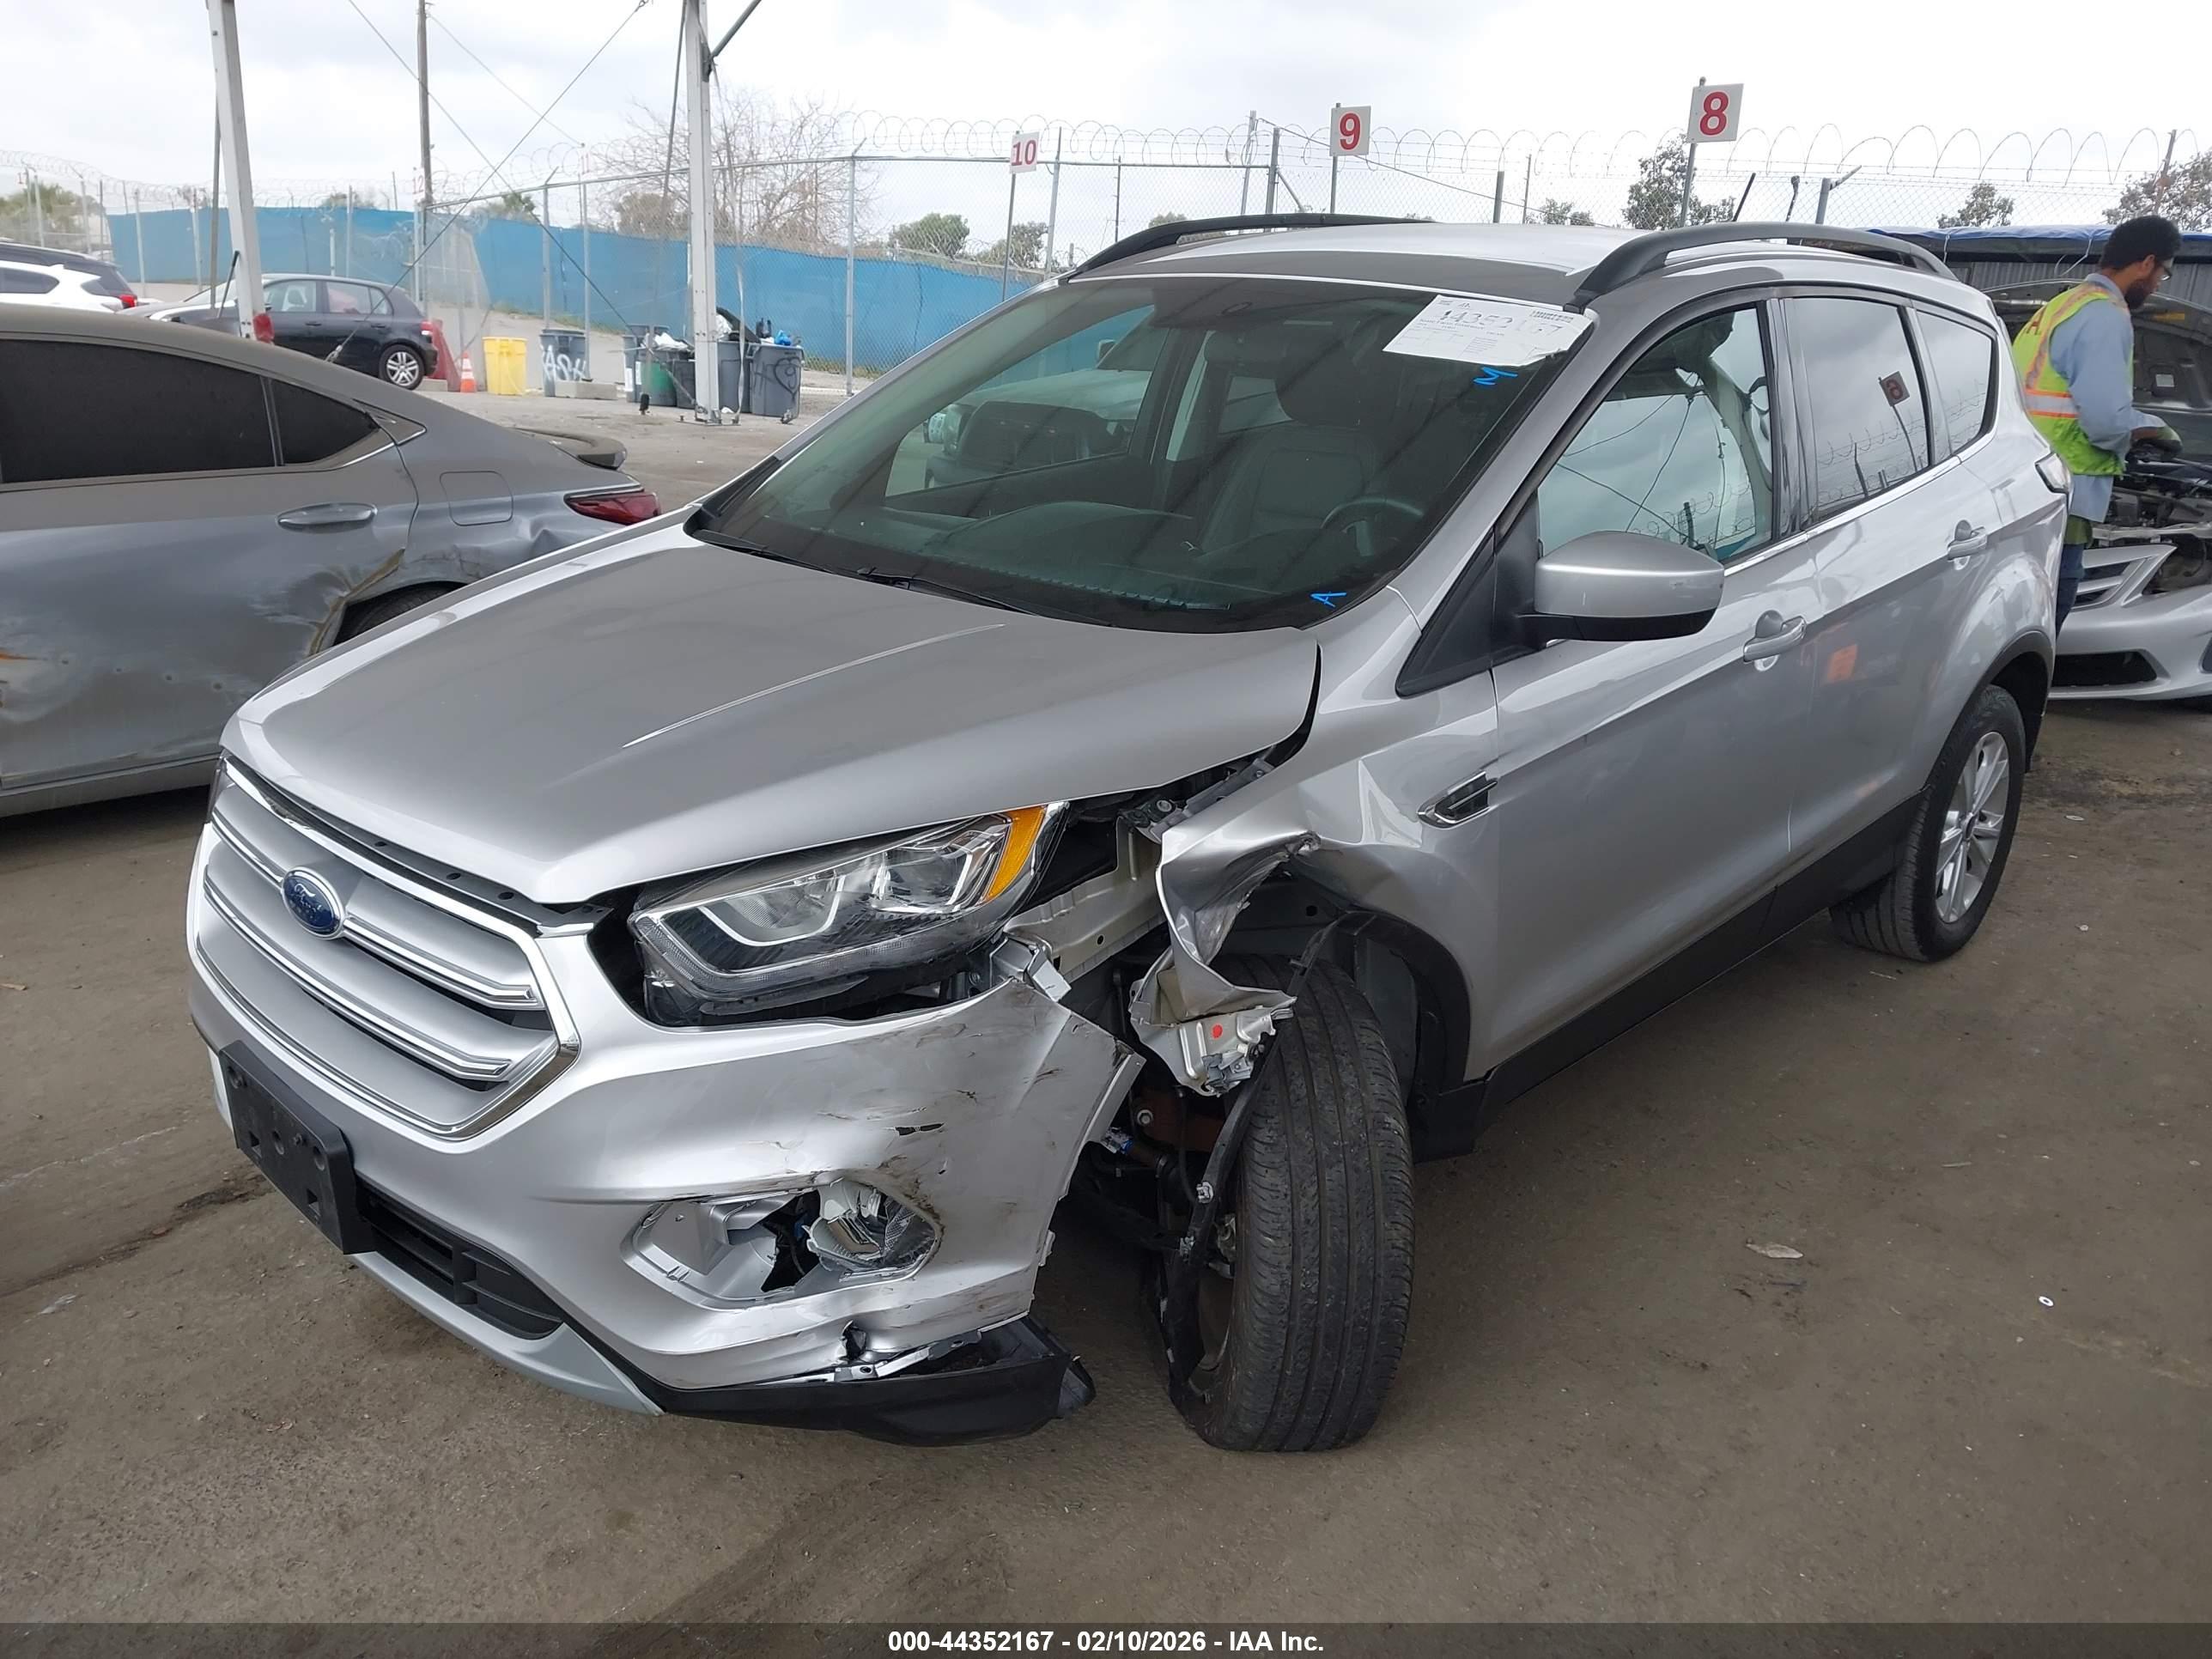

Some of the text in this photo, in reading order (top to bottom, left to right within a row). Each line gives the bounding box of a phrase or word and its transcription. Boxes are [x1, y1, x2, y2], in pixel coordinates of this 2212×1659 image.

[1340, 112, 1361, 150] 9
[1700, 92, 1729, 136] 8
[1012, 139, 1036, 166] 10
